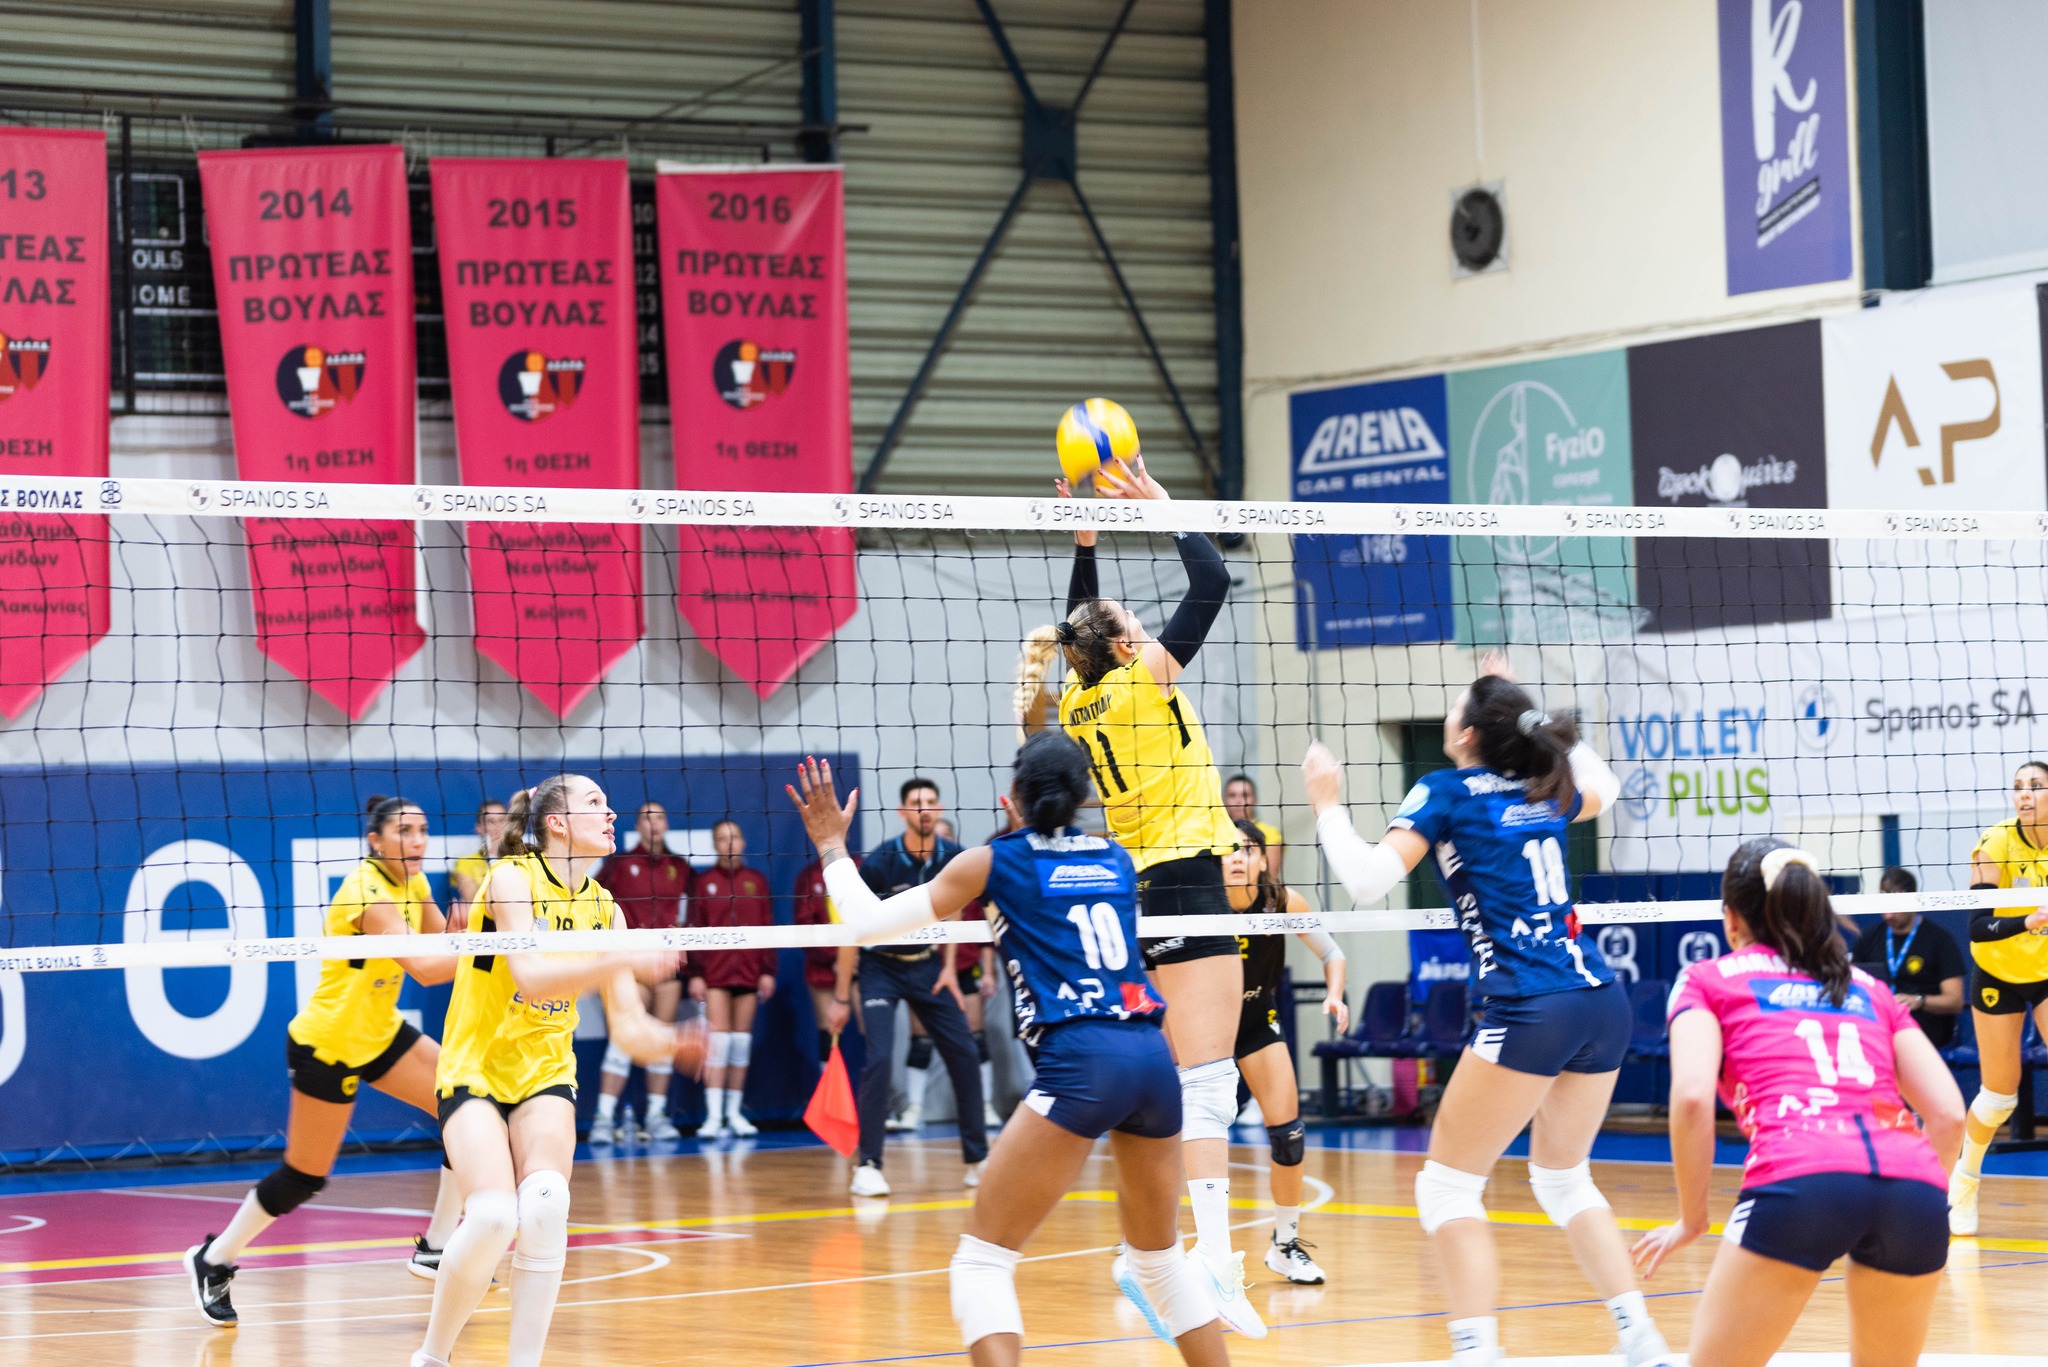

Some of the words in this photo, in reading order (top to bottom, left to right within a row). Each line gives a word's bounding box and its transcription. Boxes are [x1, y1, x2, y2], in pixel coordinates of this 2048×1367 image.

[259, 188, 353, 220] 2014
[488, 199, 577, 228] 2015
[708, 192, 791, 223] 2016
[132, 249, 183, 270] OULS
[228, 249, 391, 282] ΠΡΩΤΕΑΣ
[676, 250, 826, 280] ΠΡΩΤΕΑΣ
[457, 259, 614, 286] ΠΡΩΤΕΑΣ
[132, 285, 190, 306] OME
[687, 291, 818, 319] ΒΟΥΛΑΣ
[243, 292, 386, 324] ΒΟΥΛΑΣ
[470, 300, 607, 327] ΒΟΥΛΑΣ
[745, 441, 798, 460] ΘΕΣΗ
[1300, 406, 1446, 475] ARENA
[316, 449, 374, 469] ΘΕΣΗ
[534, 452, 591, 471] ΘΕΣΗ
[1297, 476, 1345, 495] CAR
[1352, 468, 1446, 490] RENTAL
[17, 489, 83, 508] ΒΟΥΛΑΣ
[220, 488, 298, 509] SPANOS
[304, 490, 329, 509] SA
[443, 494, 518, 513] SPANOS
[524, 495, 547, 513] SA
[656, 498, 727, 516] SPANOS
[733, 499, 756, 516] SA
[859, 501, 927, 520] SPANOS
[932, 503, 954, 521] SA
[1053, 504, 1118, 522] SPANOS
[1124, 506, 1144, 523] SA
[1238, 508, 1300, 526] SPANOS
[1305, 509, 1326, 526] SA
[1416, 510, 1475, 528] SPANOS
[1480, 512, 1499, 528] SA
[1586, 513, 1643, 529] SPANOS
[1648, 513, 1666, 529] SA
[1750, 514, 1803, 530] SPANOS
[1808, 515, 1826, 531] SA
[1905, 517, 1958, 532] SPANOS
[1962, 517, 1980, 533] SA
[1866, 698, 1981, 741] Spanos
[1992, 689, 2038, 727] SA
[1619, 706, 1766, 760] VOLLEY
[1078, 730, 1128, 798] 11
[1669, 766, 1771, 818] PLUS
[1263, 918, 1304, 930] SPANOS
[1307, 917, 1322, 929] SA
[467, 937, 518, 951] SPANOS
[521, 936, 538, 950] SA
[680, 932, 729, 946] SPANOS
[732, 932, 748, 945] SA
[1066, 902, 1128, 970] 10
[245, 944, 297, 957] SPANOS
[301, 943, 319, 956] SA
[1794, 1018, 1876, 1087] 14
